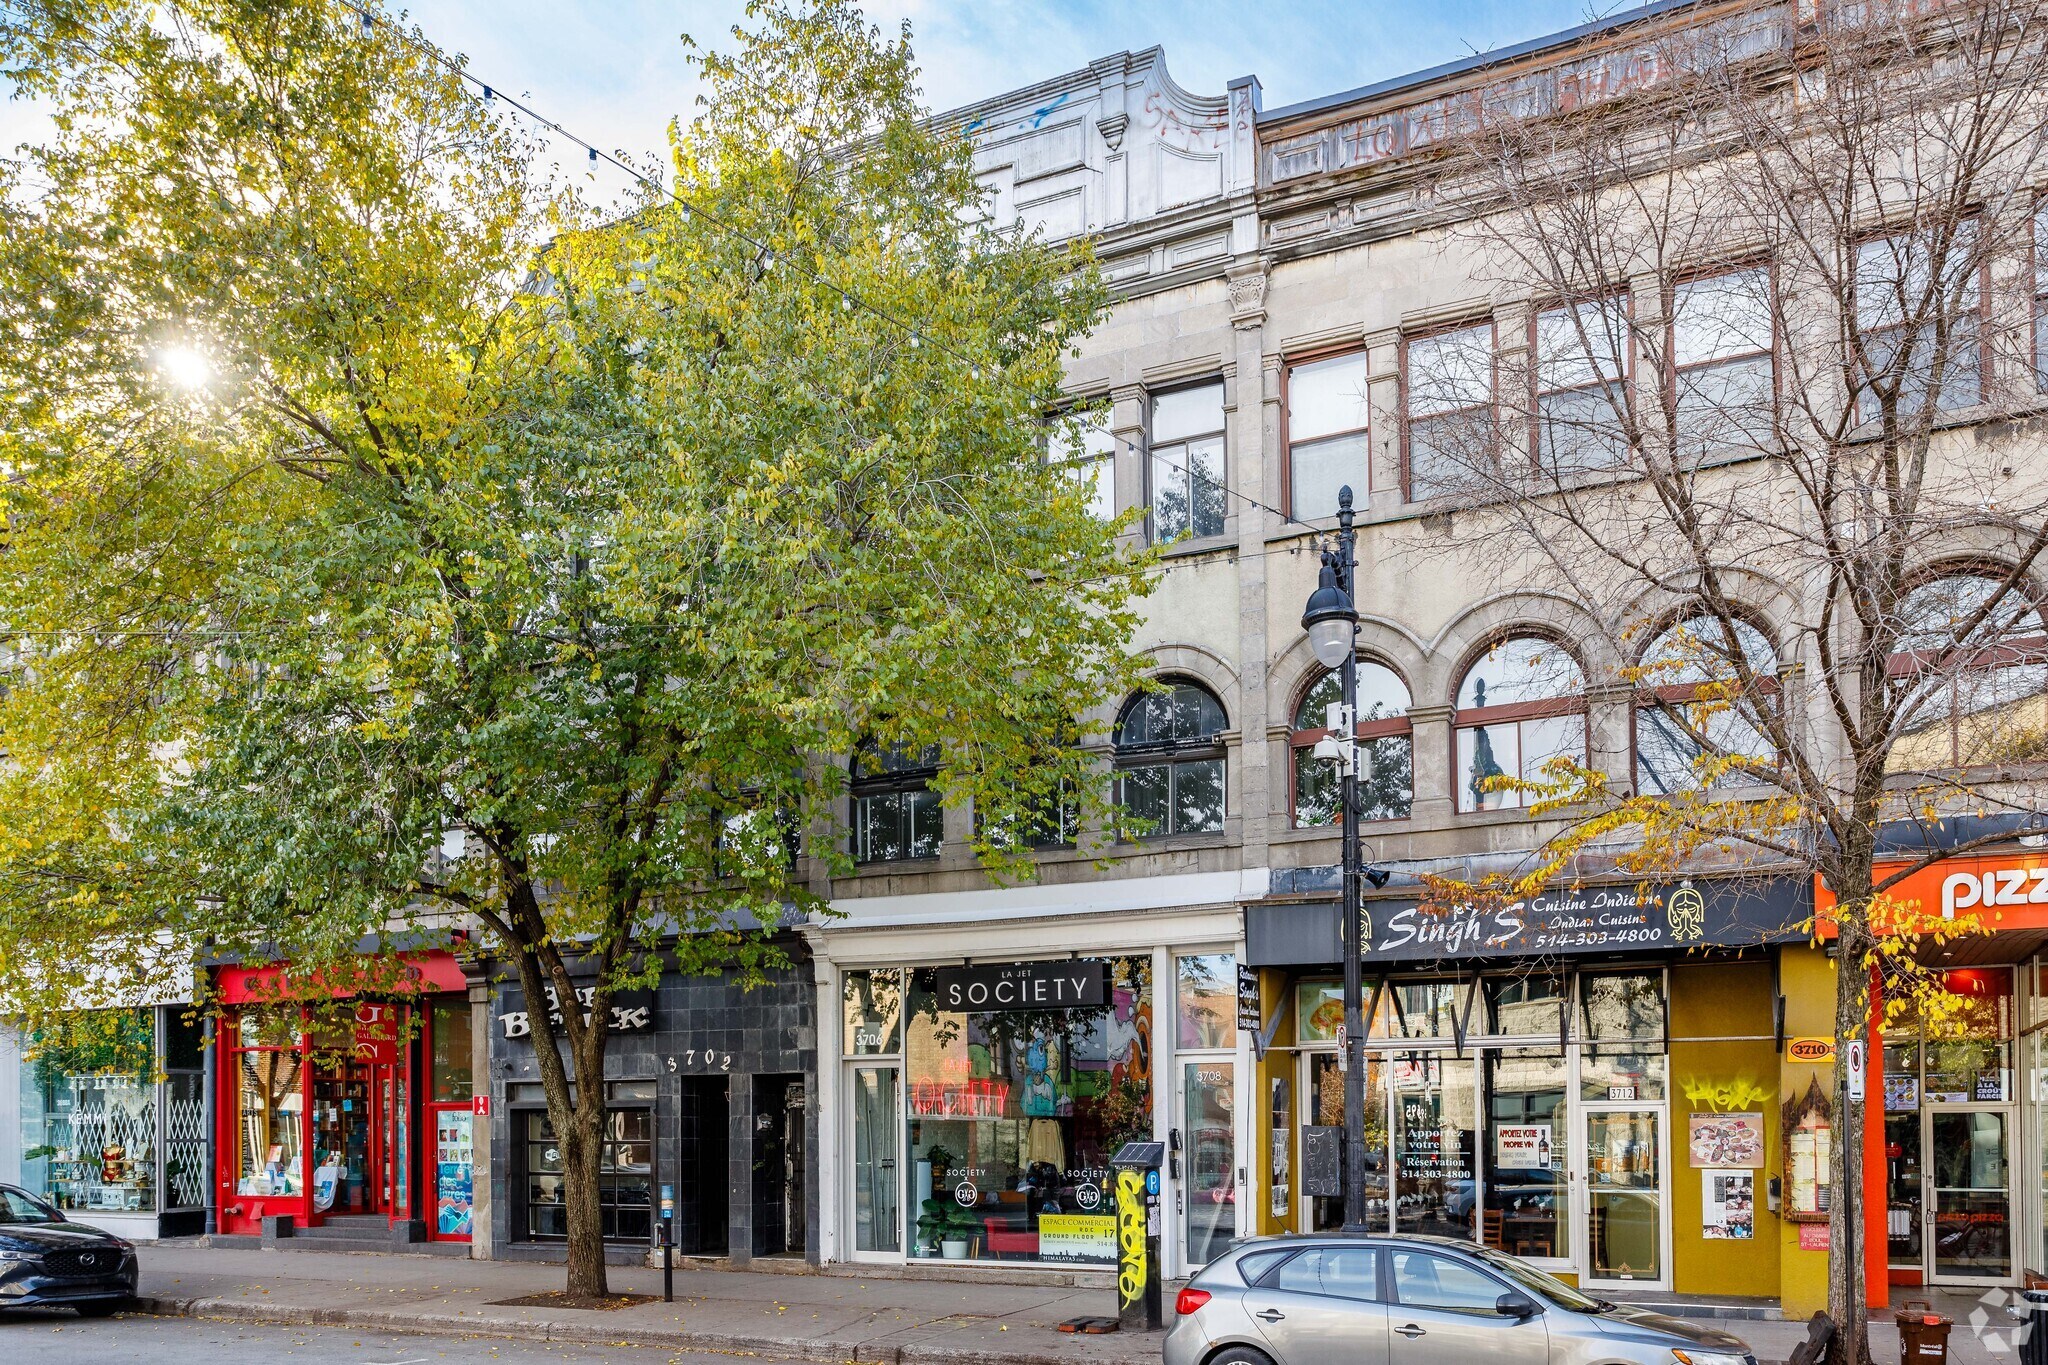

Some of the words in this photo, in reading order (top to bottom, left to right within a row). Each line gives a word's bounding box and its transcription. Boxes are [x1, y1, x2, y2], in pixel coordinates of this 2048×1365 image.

[1531, 897, 1587, 913] Cuisine
[1535, 928, 1662, 948] 514-303-4800
[1016, 969, 1032, 978] JET
[949, 976, 1088, 1006] SOCIETY
[856, 1033, 883, 1047] 3706
[1794, 1044, 1826, 1055] 3710
[1195, 1071, 1222, 1082] 3708
[1611, 1088, 1633, 1099] 3712
[1407, 1129, 1464, 1139] Apportez
[1499, 1129, 1522, 1138] APPORTEZ
[1523, 1129, 1537, 1139] VOTRE
[1409, 1141, 1440, 1149] votre
[1443, 1140, 1462, 1149] vin
[1524, 1141, 1534, 1149] VIN
[1406, 1157, 1465, 1167] Réservation
[946, 1168, 986, 1177] SOCIETY
[1067, 1169, 1110, 1179] SOCIETY
[1402, 1170, 1471, 1179] 514-303-4800
[439, 1174, 458, 1186] des
[1043, 1218, 1066, 1226] ESPACE
[1068, 1219, 1115, 1227] COMMERCIAL
